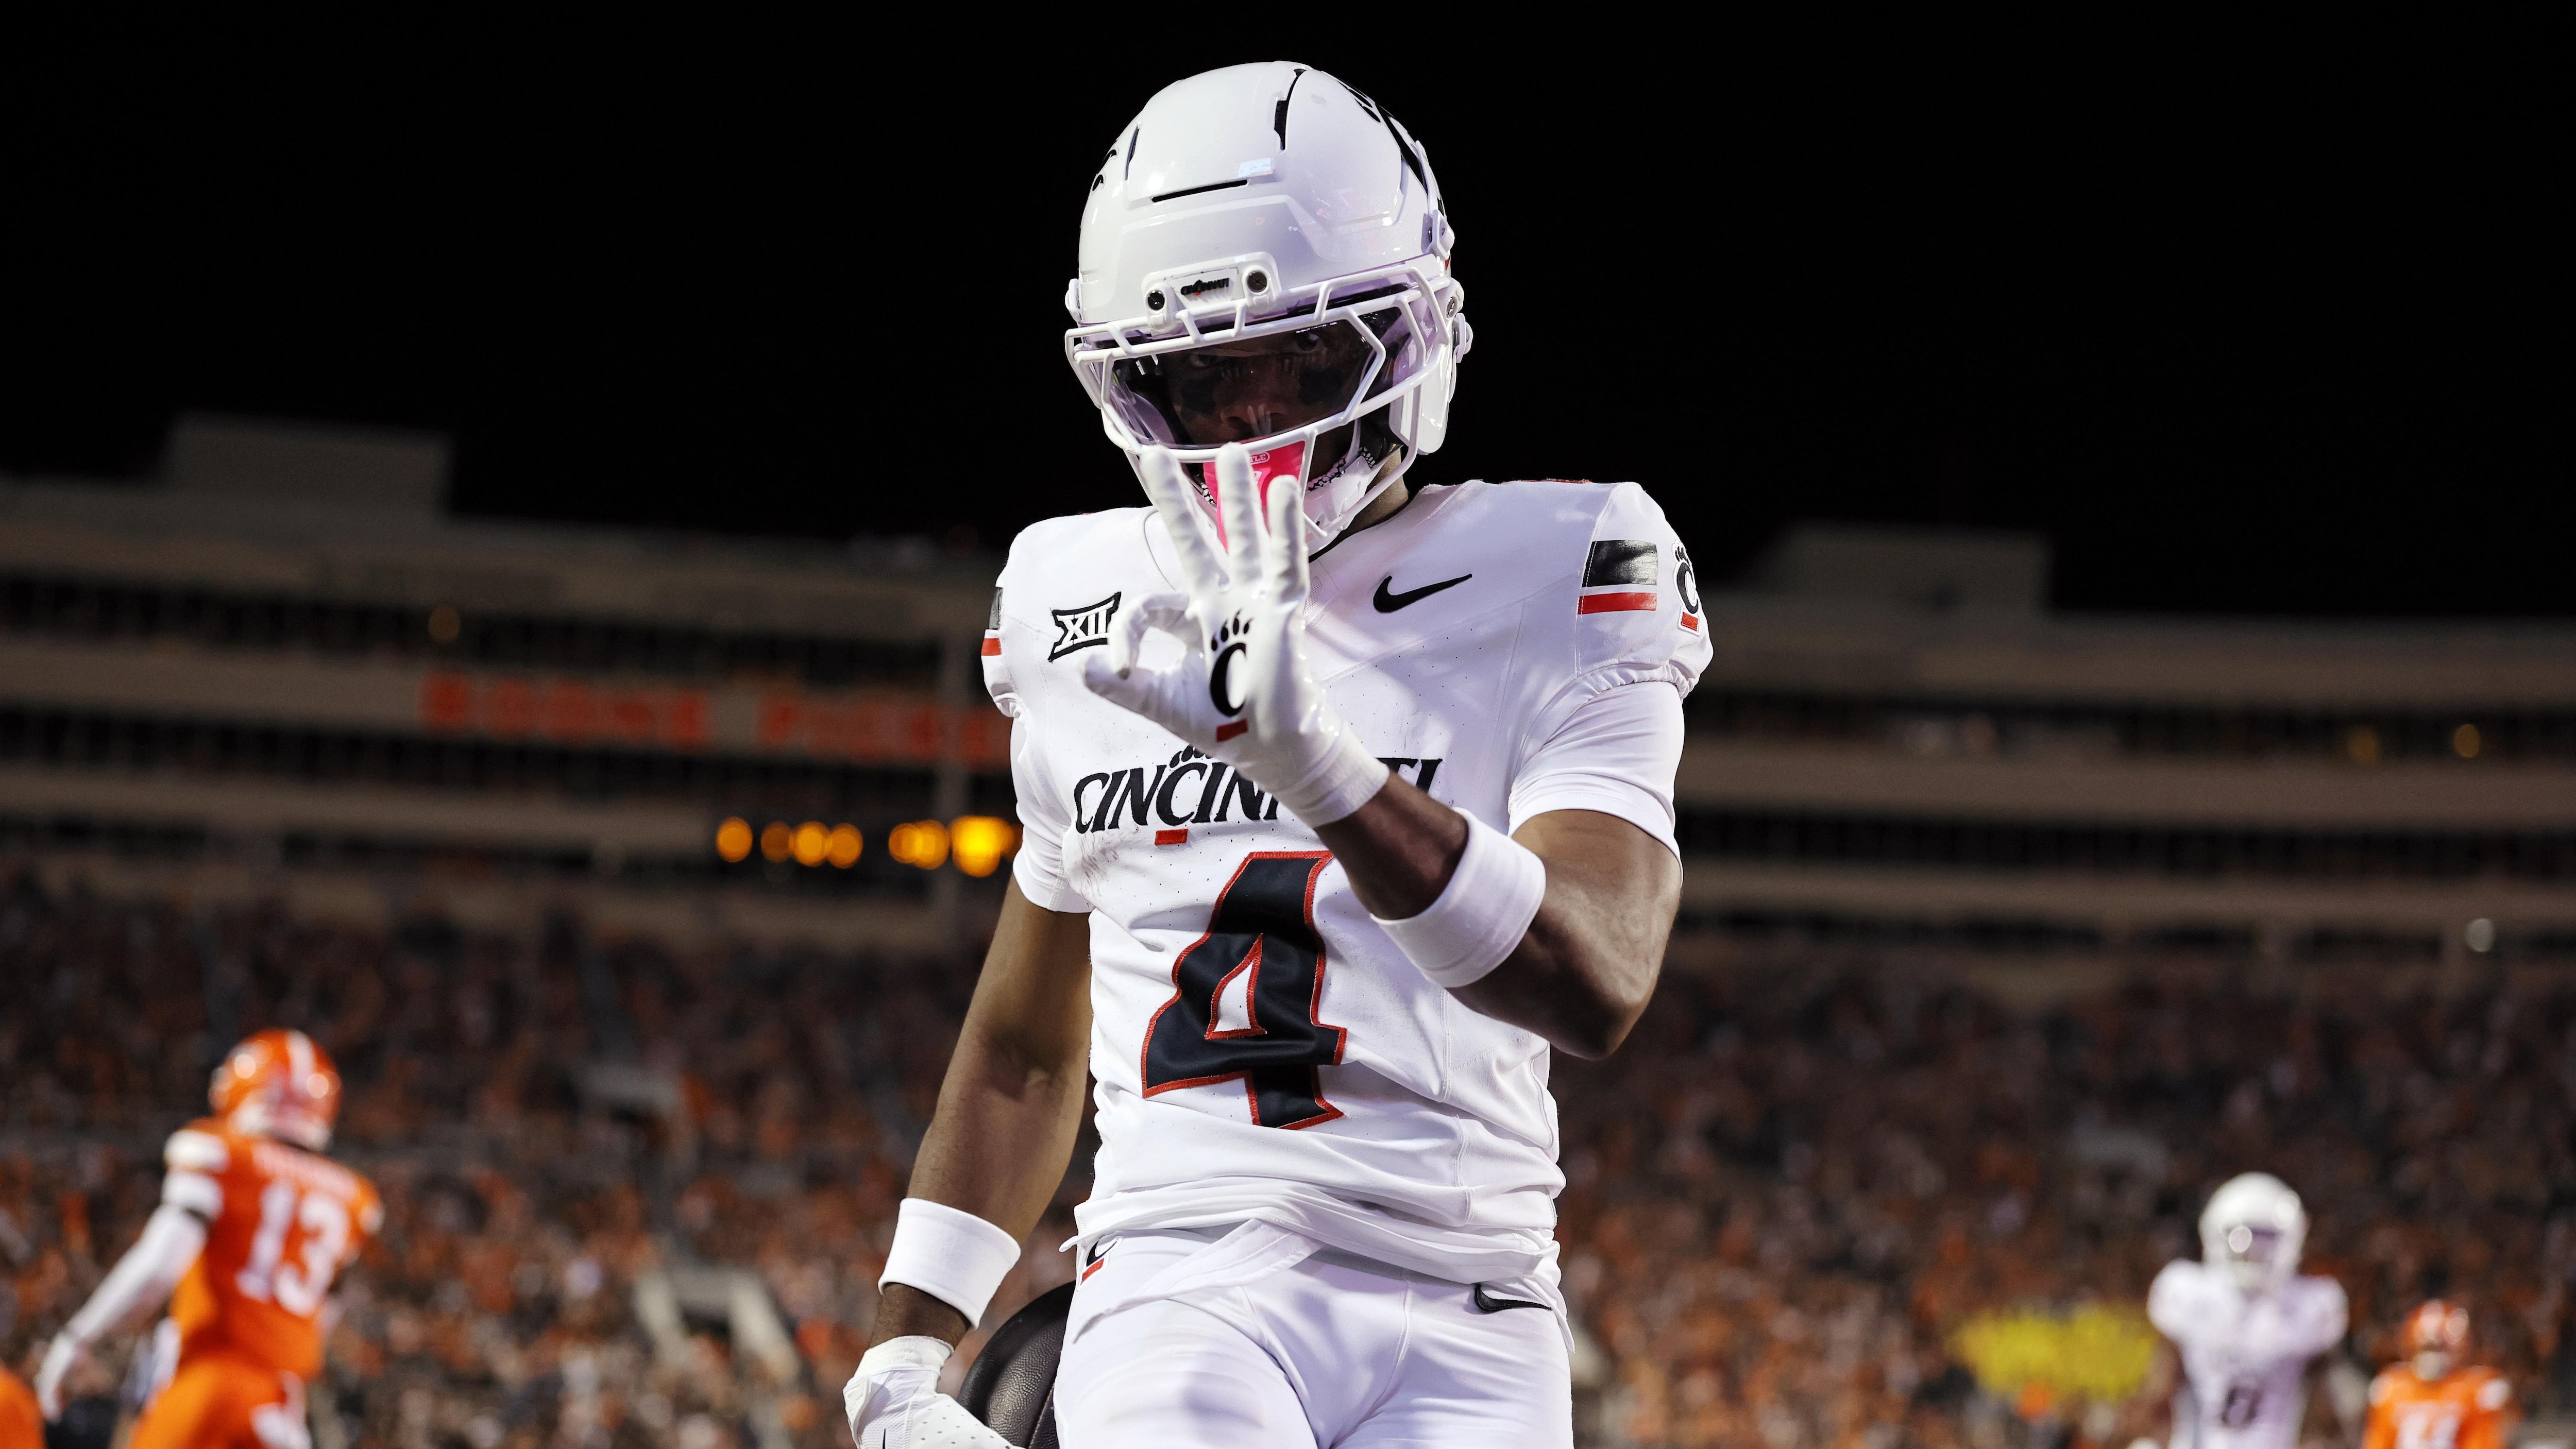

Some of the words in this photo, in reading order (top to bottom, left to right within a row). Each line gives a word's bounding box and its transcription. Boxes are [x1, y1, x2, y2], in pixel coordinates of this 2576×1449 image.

[1053, 599, 1116, 654] XII
[1074, 755, 1444, 834] CINCINTI
[1141, 850, 1347, 1130] 4
[235, 1177, 351, 1317] 13
